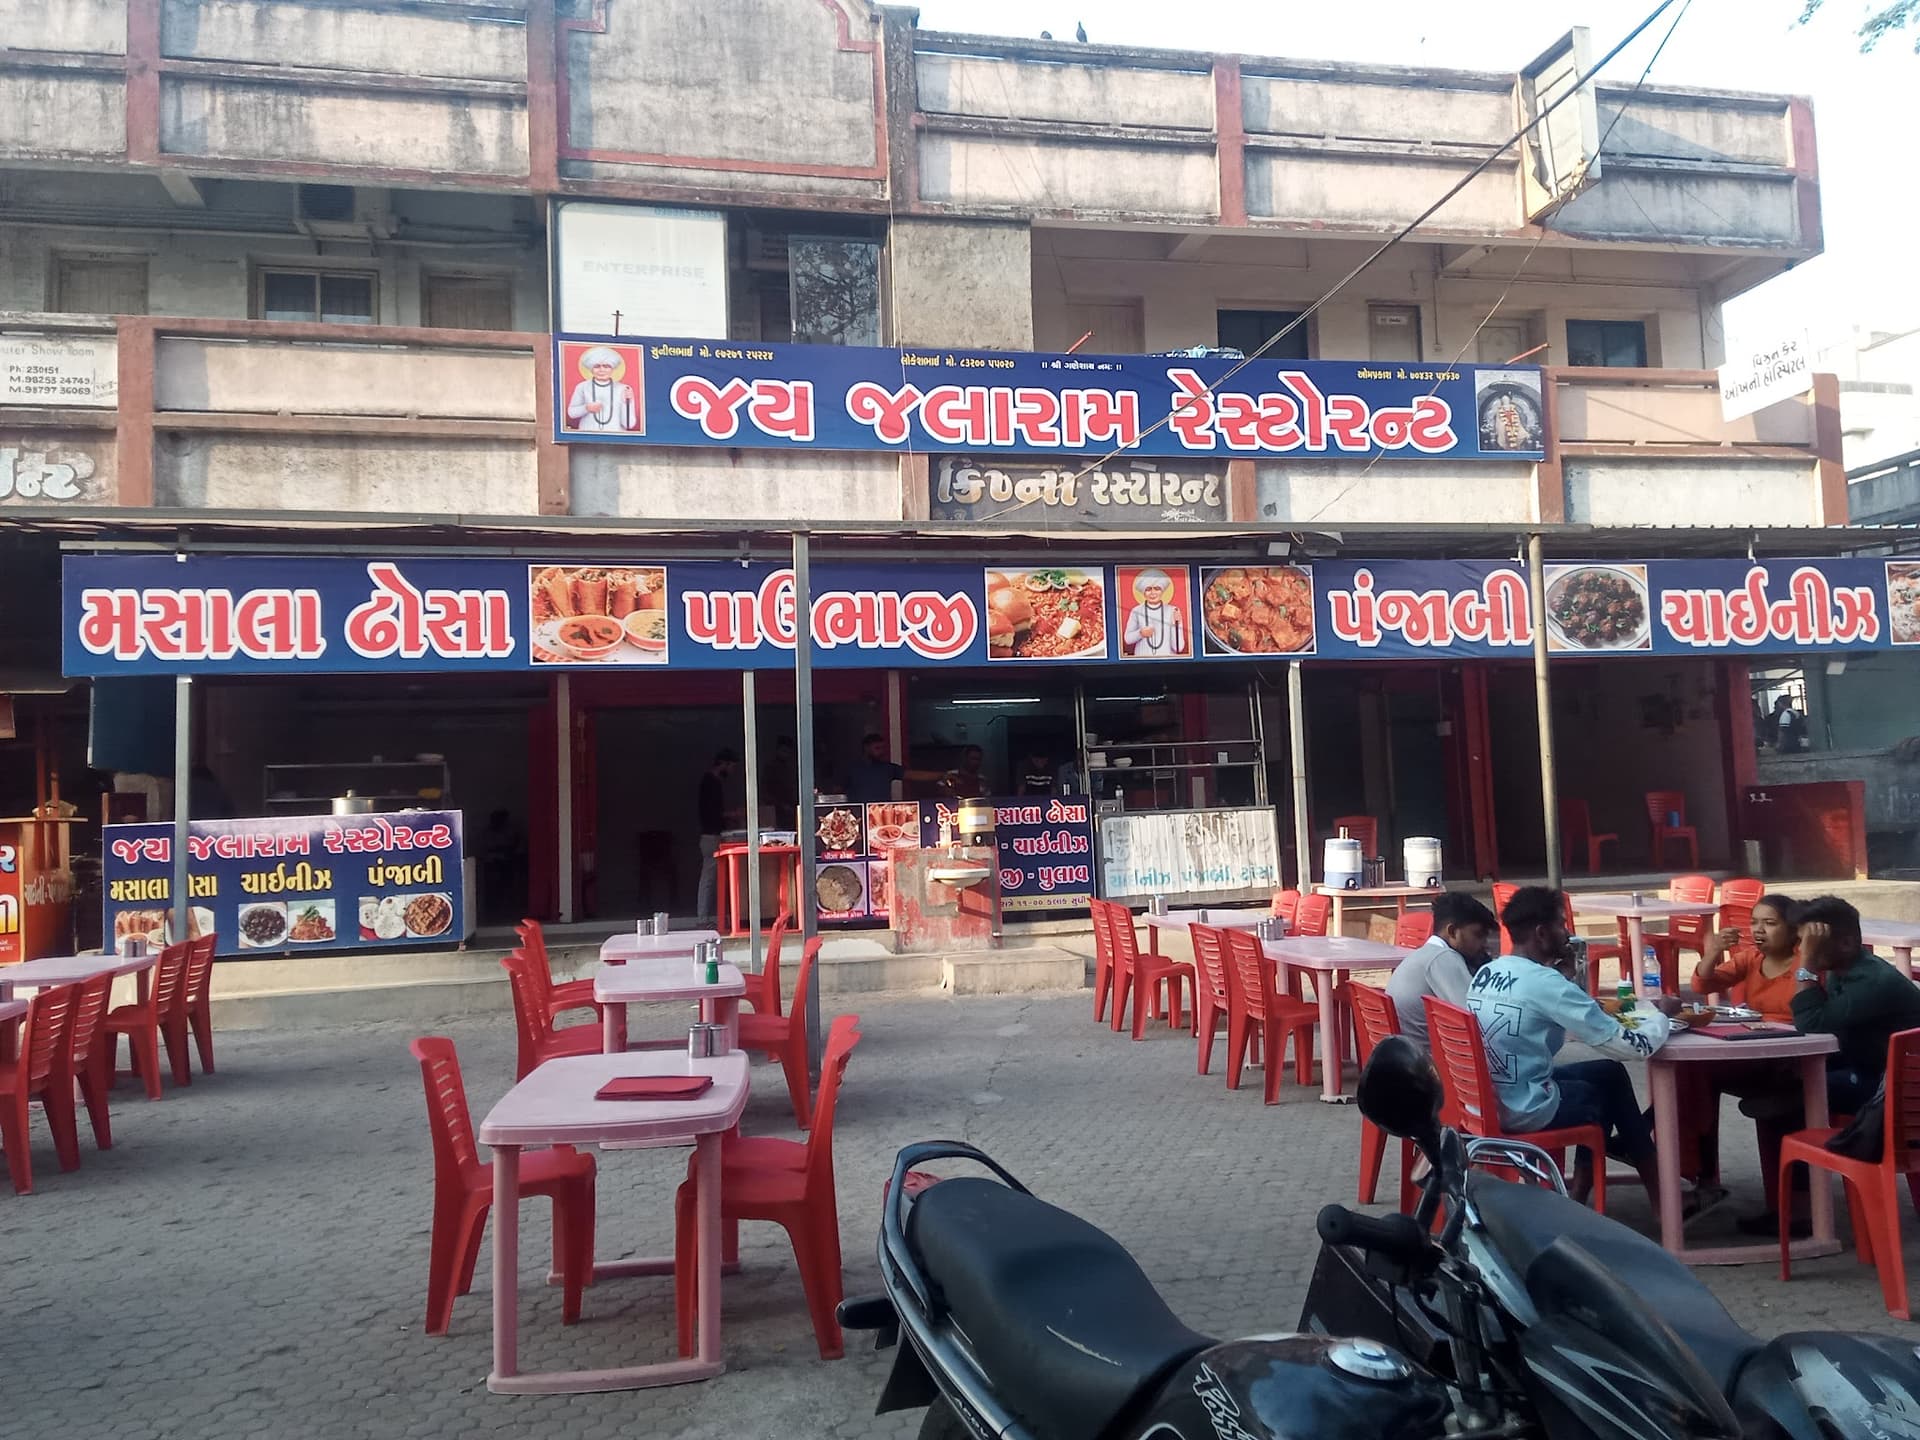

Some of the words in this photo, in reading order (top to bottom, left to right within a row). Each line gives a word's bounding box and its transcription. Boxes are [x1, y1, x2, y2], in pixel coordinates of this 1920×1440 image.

[583, 260, 705, 279] ENTERPRISE
[1050, 360, 1061, 370] શ્રી
[670, 375, 815, 441] જય
[845, 382, 1140, 449] જલારામ
[1167, 368, 1458, 453] રેસ્ટોરન્ટ
[80, 589, 326, 660] મસાલા
[345, 562, 515, 659] ઢોસા
[1328, 567, 1535, 648] પંજાબી
[1662, 566, 1880, 648] ચાઈનીઝ
[1046, 800, 1087, 824] ઢોસા
[112, 838, 171, 864] જય
[188, 832, 309, 861] જલારામ
[323, 817, 453, 853] રેસ્ટોરન્ટ
[1013, 830, 1088, 855] ચાઈનીઝ
[241, 862, 332, 895] ચાઈનીઝ
[367, 854, 443, 887] પંજાબી
[1039, 865, 1089, 890] પુલાવ
[109, 875, 169, 902] મસાલા
